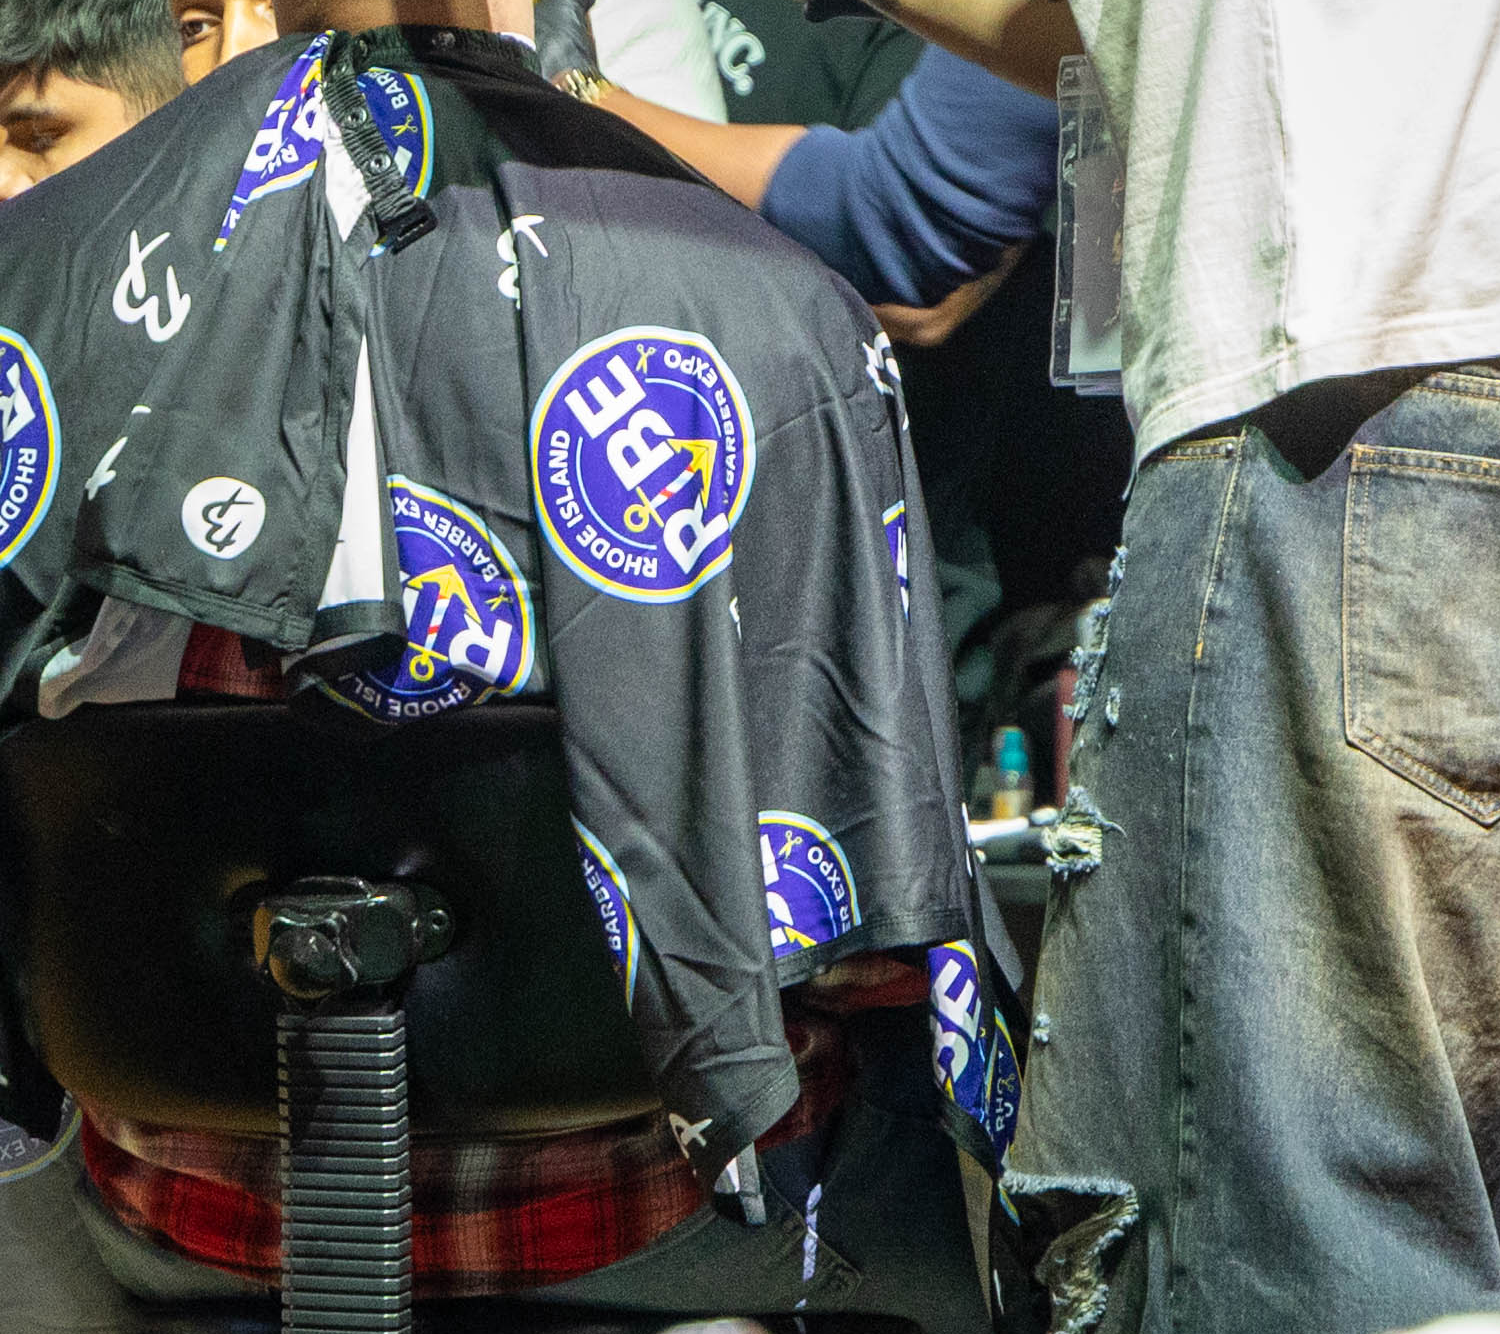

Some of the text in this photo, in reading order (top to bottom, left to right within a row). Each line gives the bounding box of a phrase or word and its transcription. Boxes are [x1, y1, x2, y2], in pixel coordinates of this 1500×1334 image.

[663, 348, 719, 389] EXPO
[548, 429, 659, 579] RHODE ISLAND
[424, 510, 501, 584] BARBER
[387, 681, 472, 717] RHODE
[807, 845, 846, 902] EXPO
